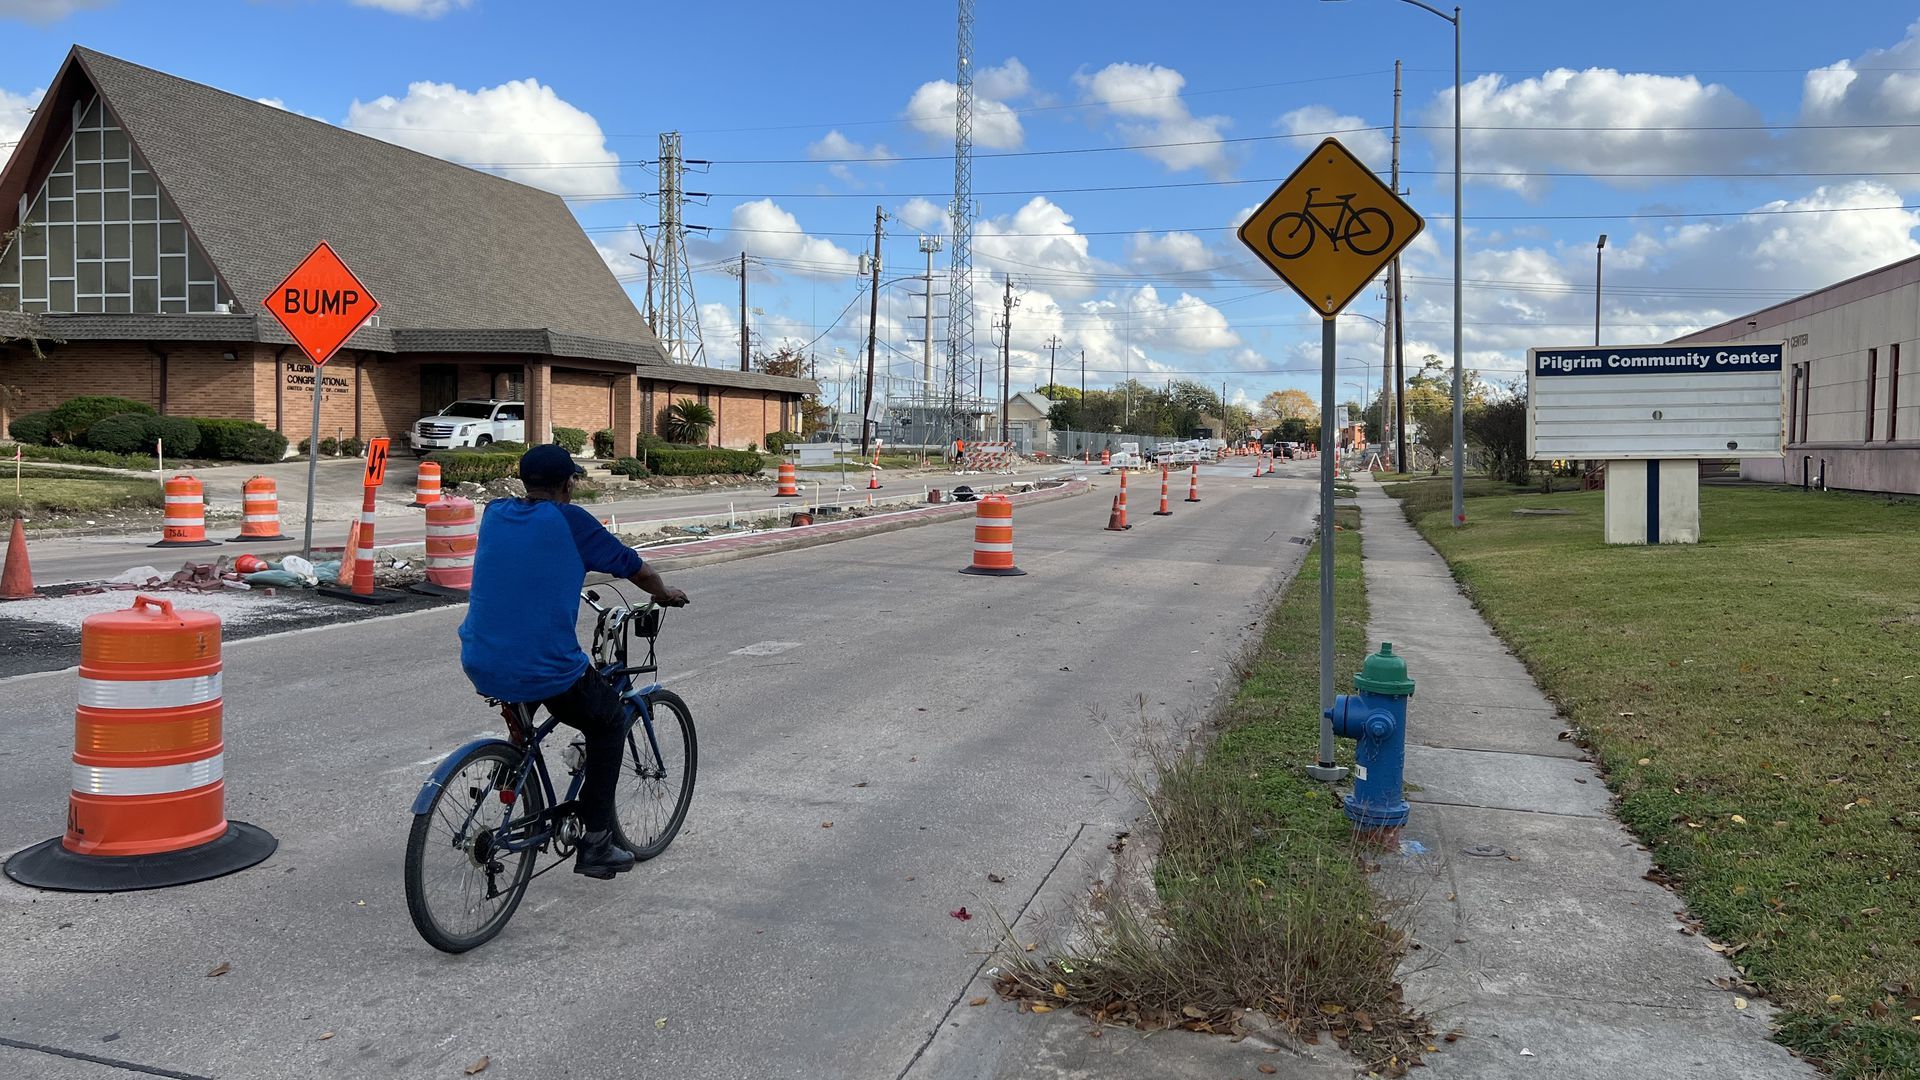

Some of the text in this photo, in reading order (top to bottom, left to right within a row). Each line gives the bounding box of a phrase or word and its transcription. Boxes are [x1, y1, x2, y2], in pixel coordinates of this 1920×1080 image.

[284, 288, 359, 315] BUMP
[286, 363, 314, 373] PILGRIM
[1539, 351, 1779, 372] Pilgrim Community Center
[286, 375, 349, 387] CONGREATIONAL
